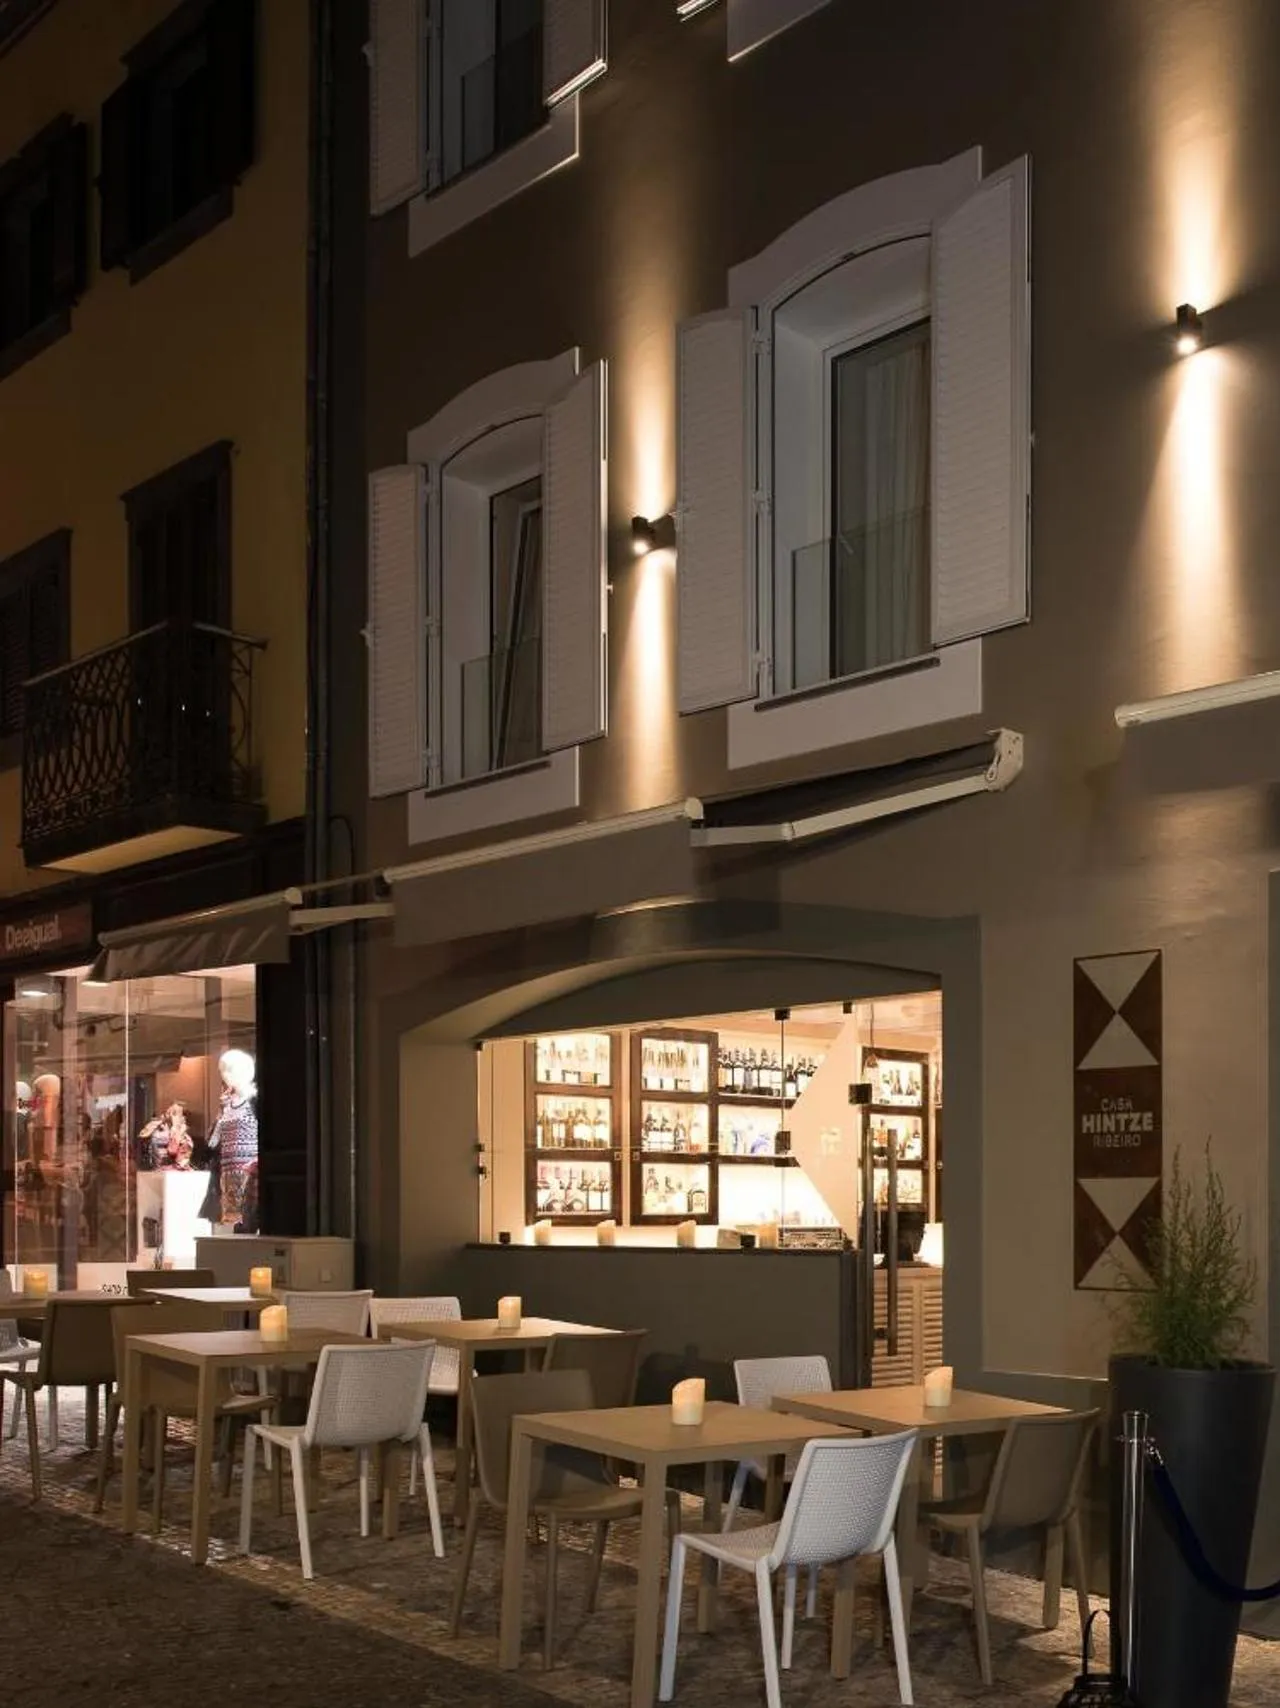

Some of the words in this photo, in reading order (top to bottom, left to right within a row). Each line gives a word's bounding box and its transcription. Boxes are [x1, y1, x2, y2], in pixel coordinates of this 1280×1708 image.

[1101, 1097, 1133, 1111] CASA
[1082, 1111, 1153, 1133] HINTZE
[1093, 1133, 1141, 1147] RIBEIRO
